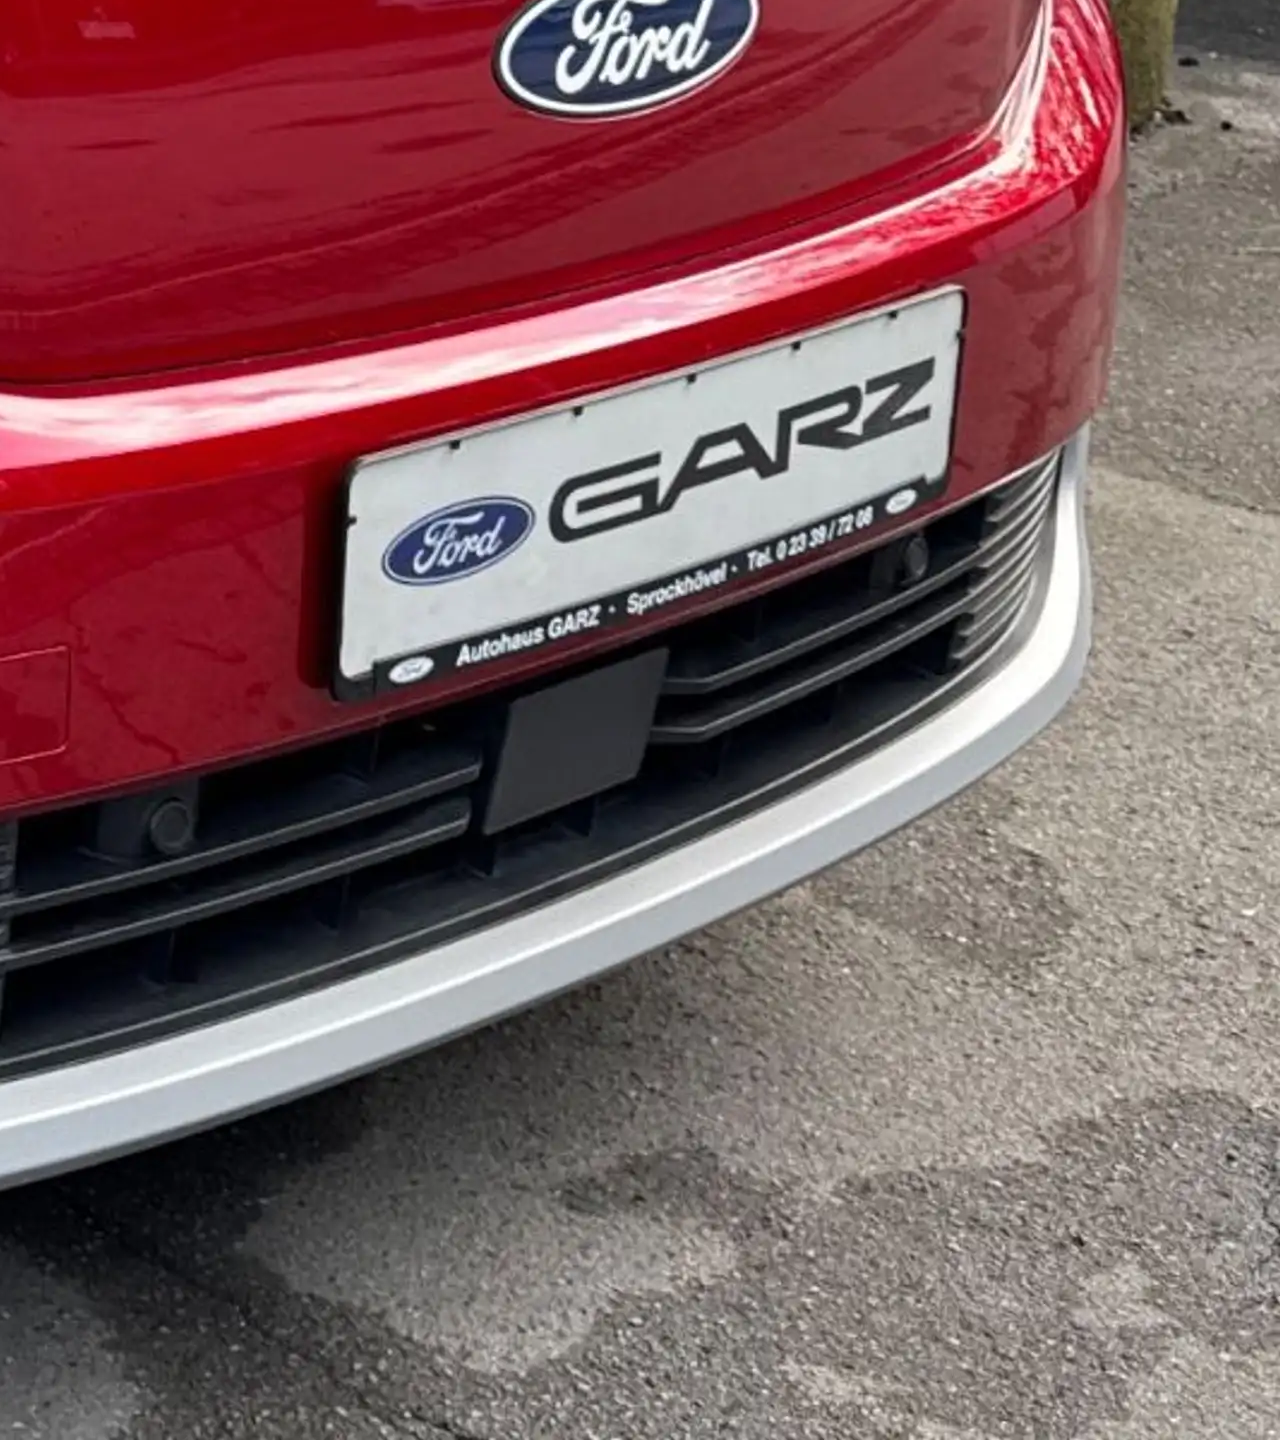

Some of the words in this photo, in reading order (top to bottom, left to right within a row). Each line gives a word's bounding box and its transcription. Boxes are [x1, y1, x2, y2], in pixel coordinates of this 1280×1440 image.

[413, 511, 506, 575] Ford
[548, 356, 936, 543] GARZ
[456, 624, 544, 667] Autohaus
[547, 604, 602, 639] GARZ
[627, 561, 728, 615] Sprockhövel
[746, 546, 773, 572] Tel.
